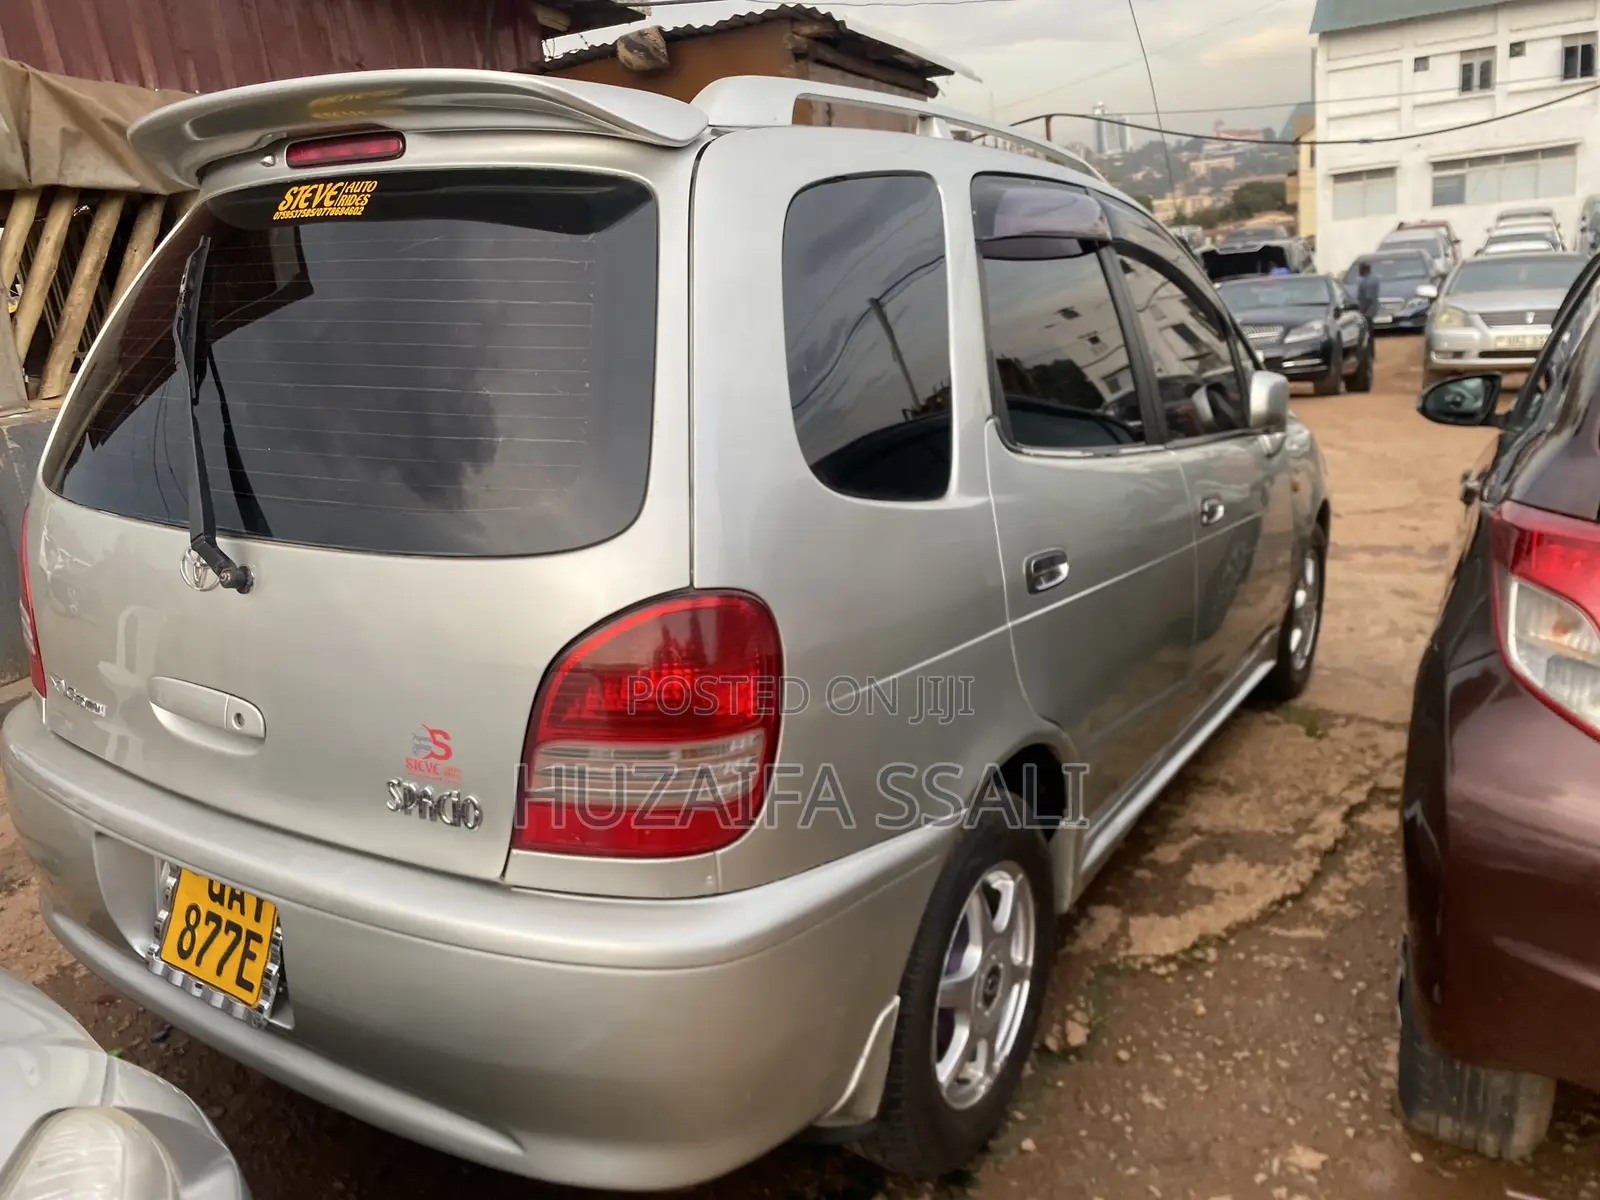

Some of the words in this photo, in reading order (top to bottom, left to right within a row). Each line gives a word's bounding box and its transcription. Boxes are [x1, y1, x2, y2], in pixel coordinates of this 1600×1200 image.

[278, 182, 344, 211] STEVE
[339, 193, 371, 207] RIDES
[345, 180, 378, 193] AUTO
[385, 776, 483, 831] SPACIO
[176, 902, 264, 993] 877E
